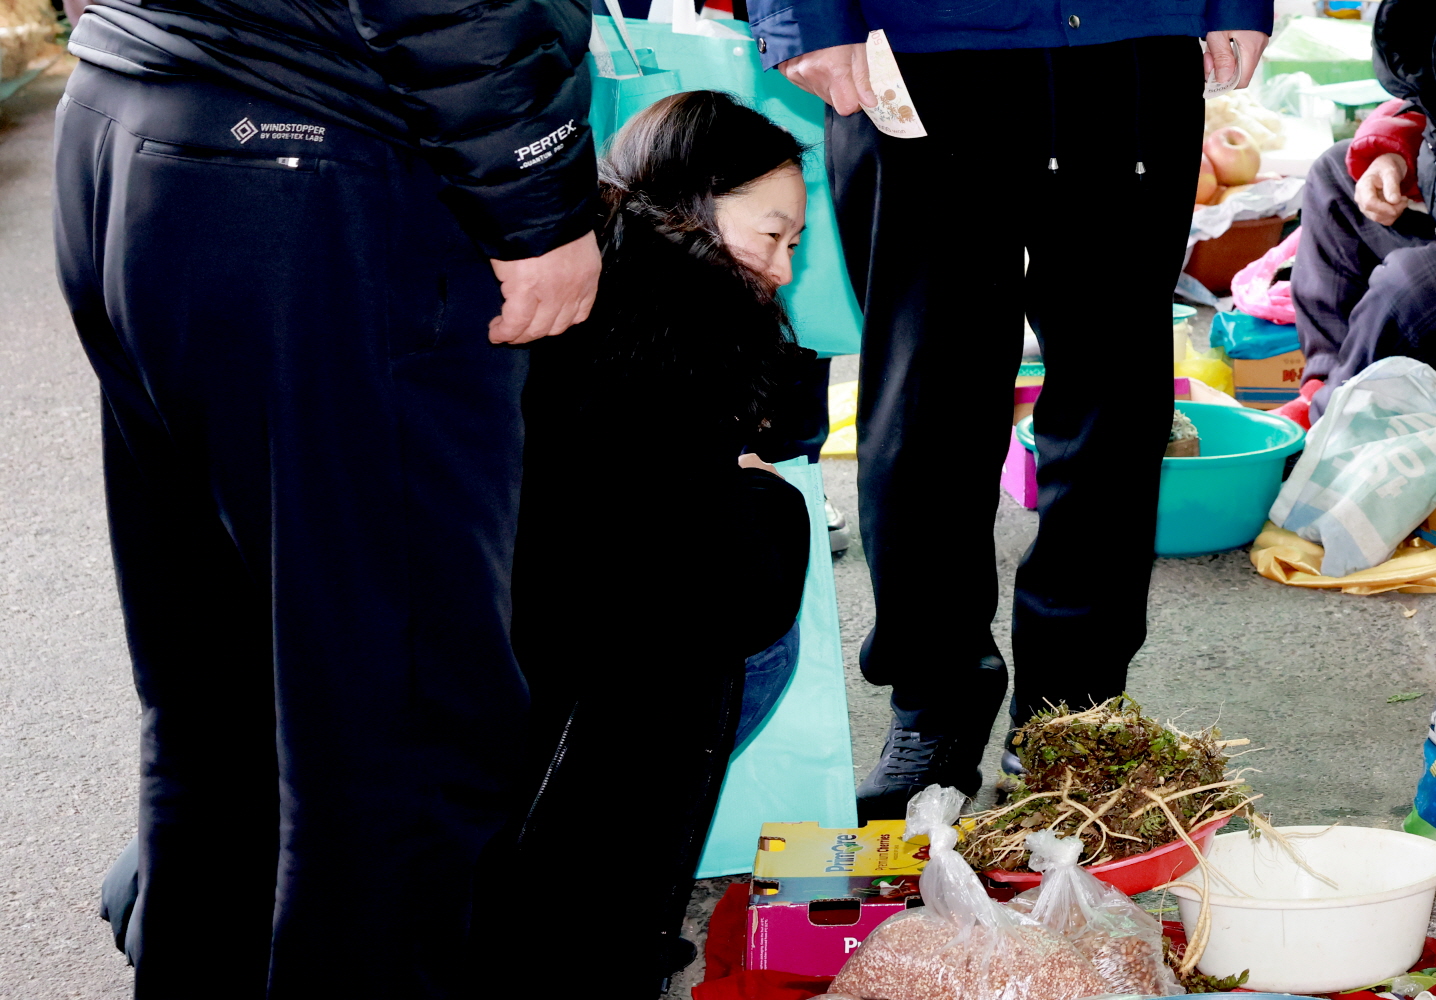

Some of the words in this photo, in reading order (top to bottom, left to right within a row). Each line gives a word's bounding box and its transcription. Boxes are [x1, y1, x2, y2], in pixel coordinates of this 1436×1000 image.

[260, 123, 326, 135] WINDSTOPPER
[305, 134, 324, 142] LABS
[517, 119, 577, 161] PERTEX
[876, 833, 890, 852] Cherries
[875, 852, 888, 871] Premium
